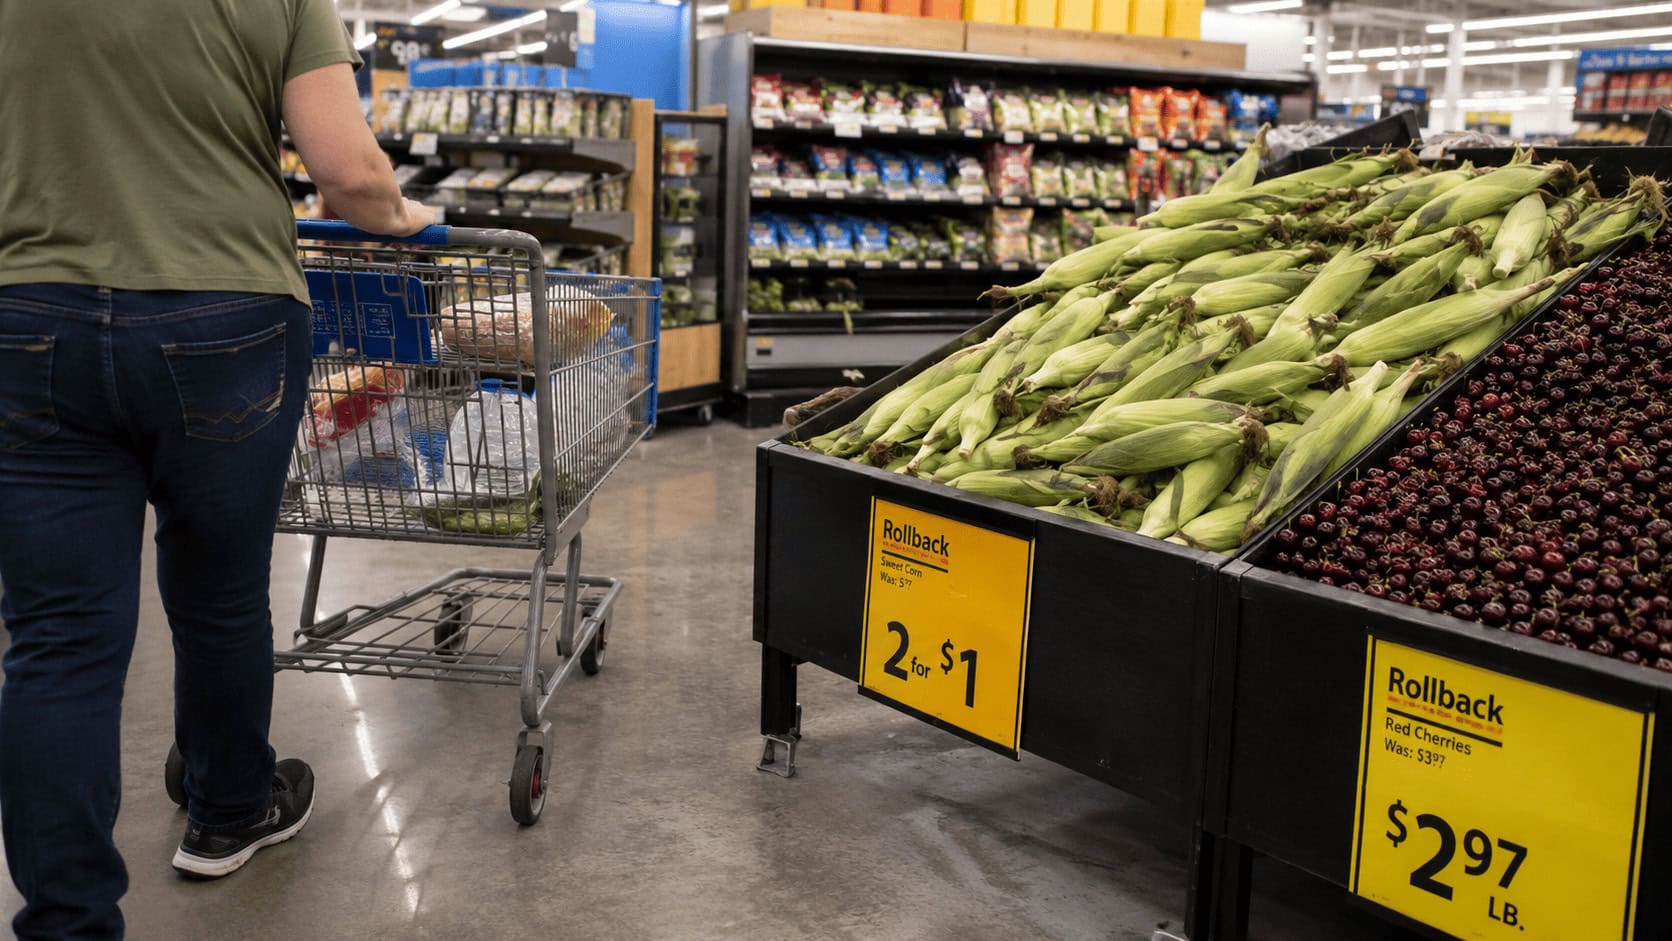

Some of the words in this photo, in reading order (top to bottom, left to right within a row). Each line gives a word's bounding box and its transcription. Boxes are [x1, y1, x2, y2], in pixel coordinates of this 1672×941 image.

[883, 518, 950, 557] Rollback
[880, 570, 897, 586] Was:
[881, 556, 904, 571] Sweet
[904, 563, 923, 578] Corn
[884, 620, 909, 681] 2
[911, 656, 932, 679] for
[1388, 666, 1504, 726] Rollback
[1384, 737, 1413, 759] Was:
[1385, 716, 1411, 736] Red
[1414, 726, 1472, 756] Cherries
[1488, 896, 1525, 931] LB.
